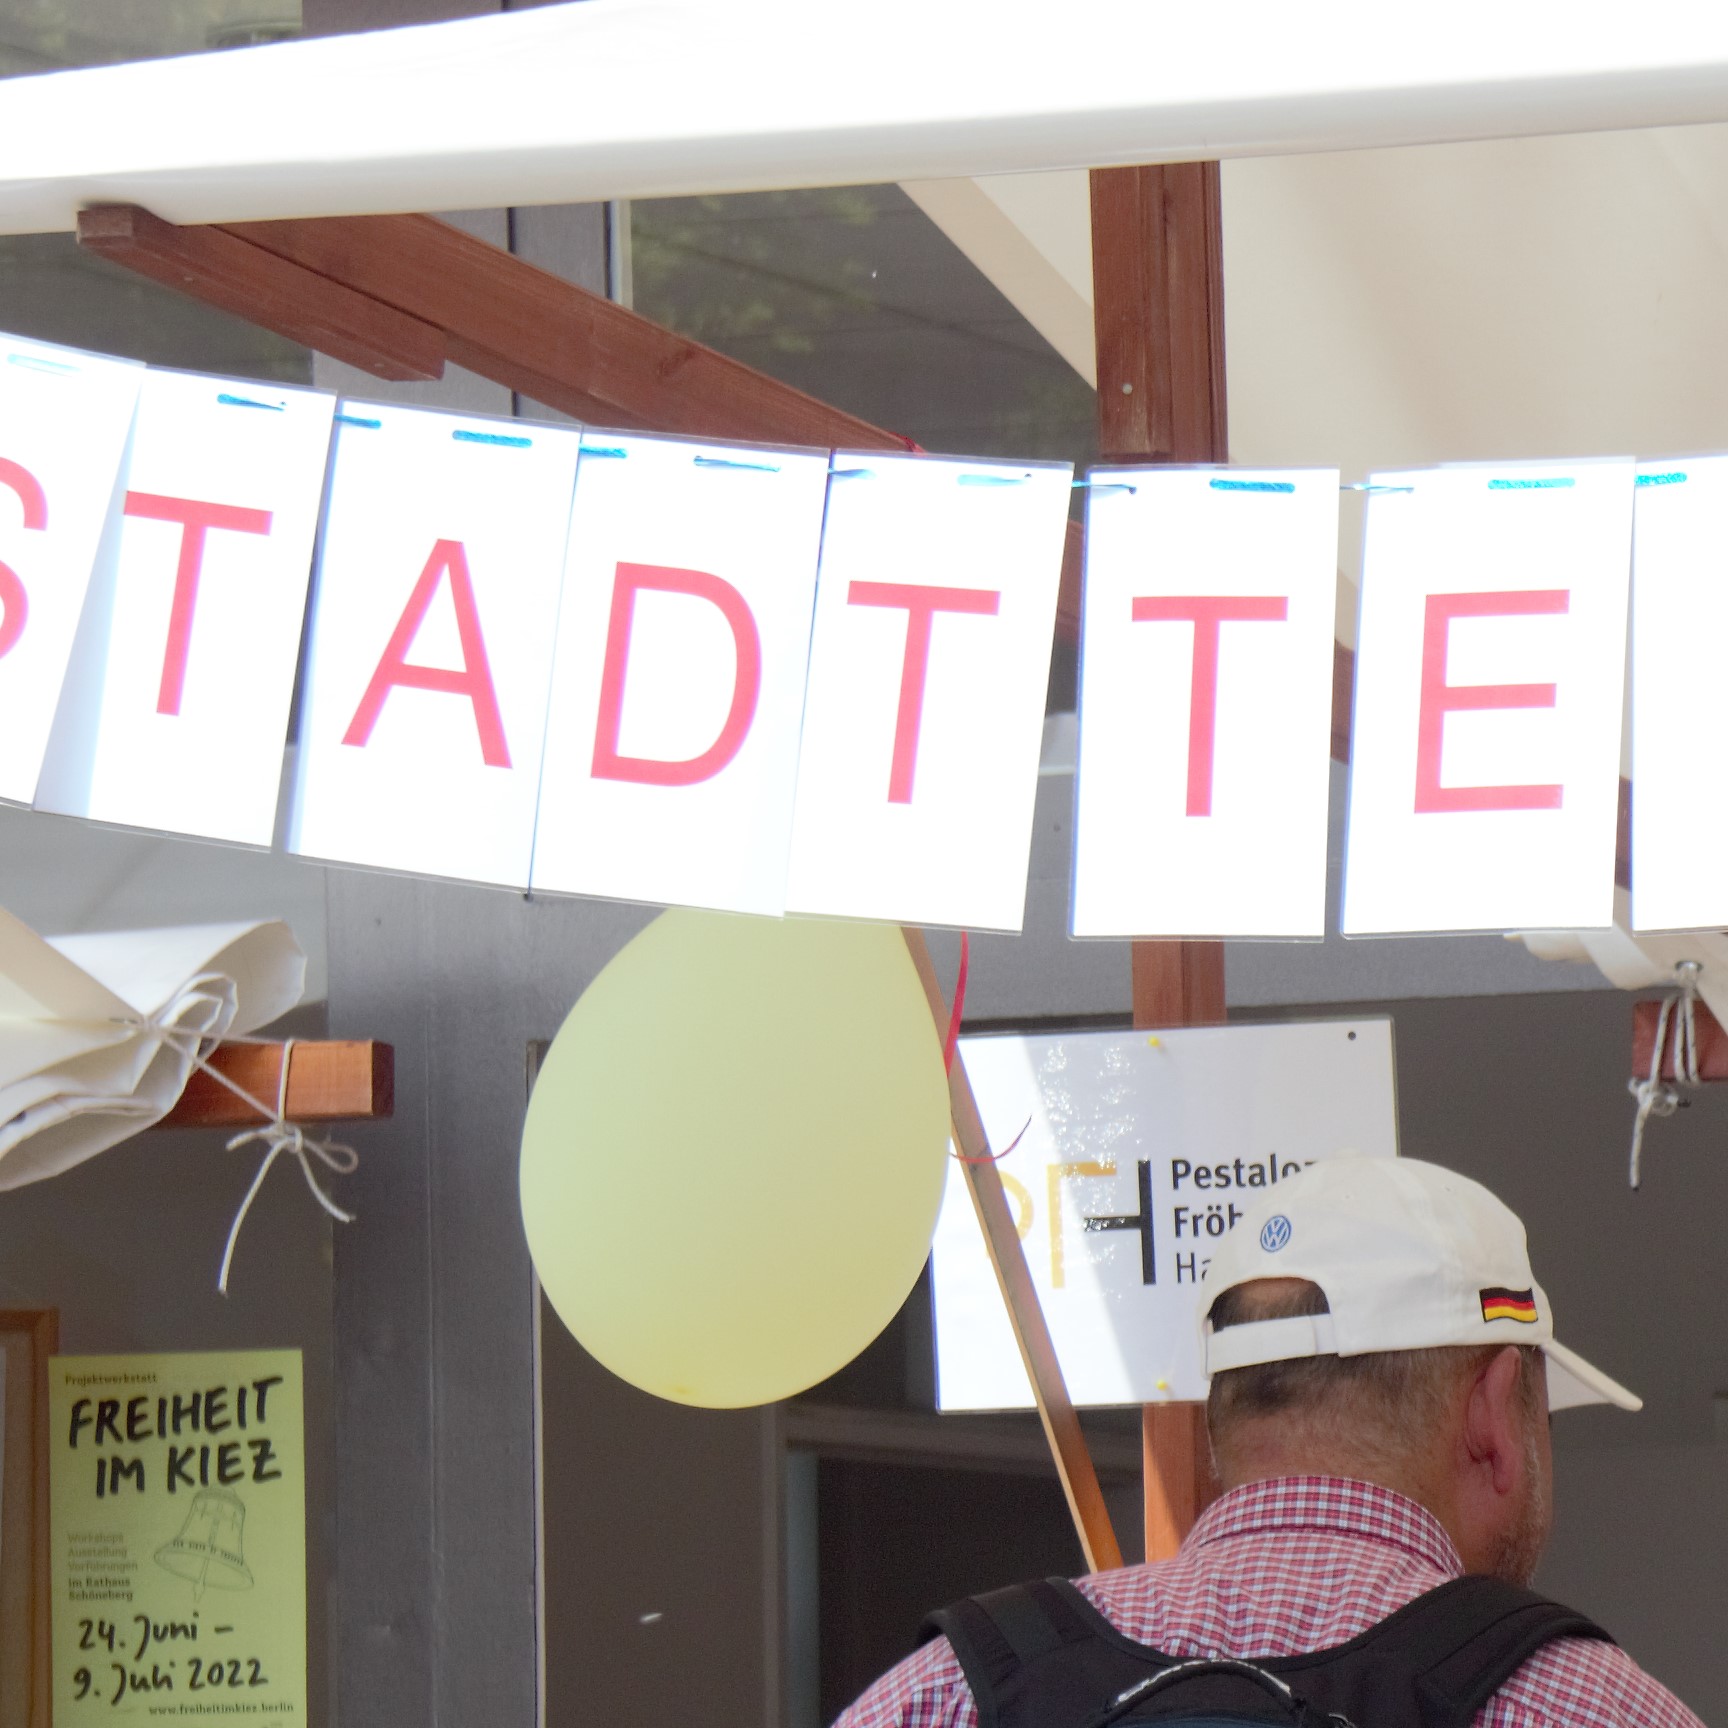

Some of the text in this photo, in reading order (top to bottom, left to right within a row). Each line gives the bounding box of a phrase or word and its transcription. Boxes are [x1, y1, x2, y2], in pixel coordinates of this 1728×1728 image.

[1171, 1153, 1318, 1190] Pestalo
[65, 1373, 158, 1387] Projektwerkstatt
[69, 1375, 284, 1449] FREIHEIT
[96, 1438, 283, 1498] IM KIEZ
[68, 1590, 134, 1602] Schöneberg
[79, 1617, 126, 1653] 24.
[134, 1610, 199, 1662] Juni
[73, 1656, 269, 1707] 9. Juli 2022
